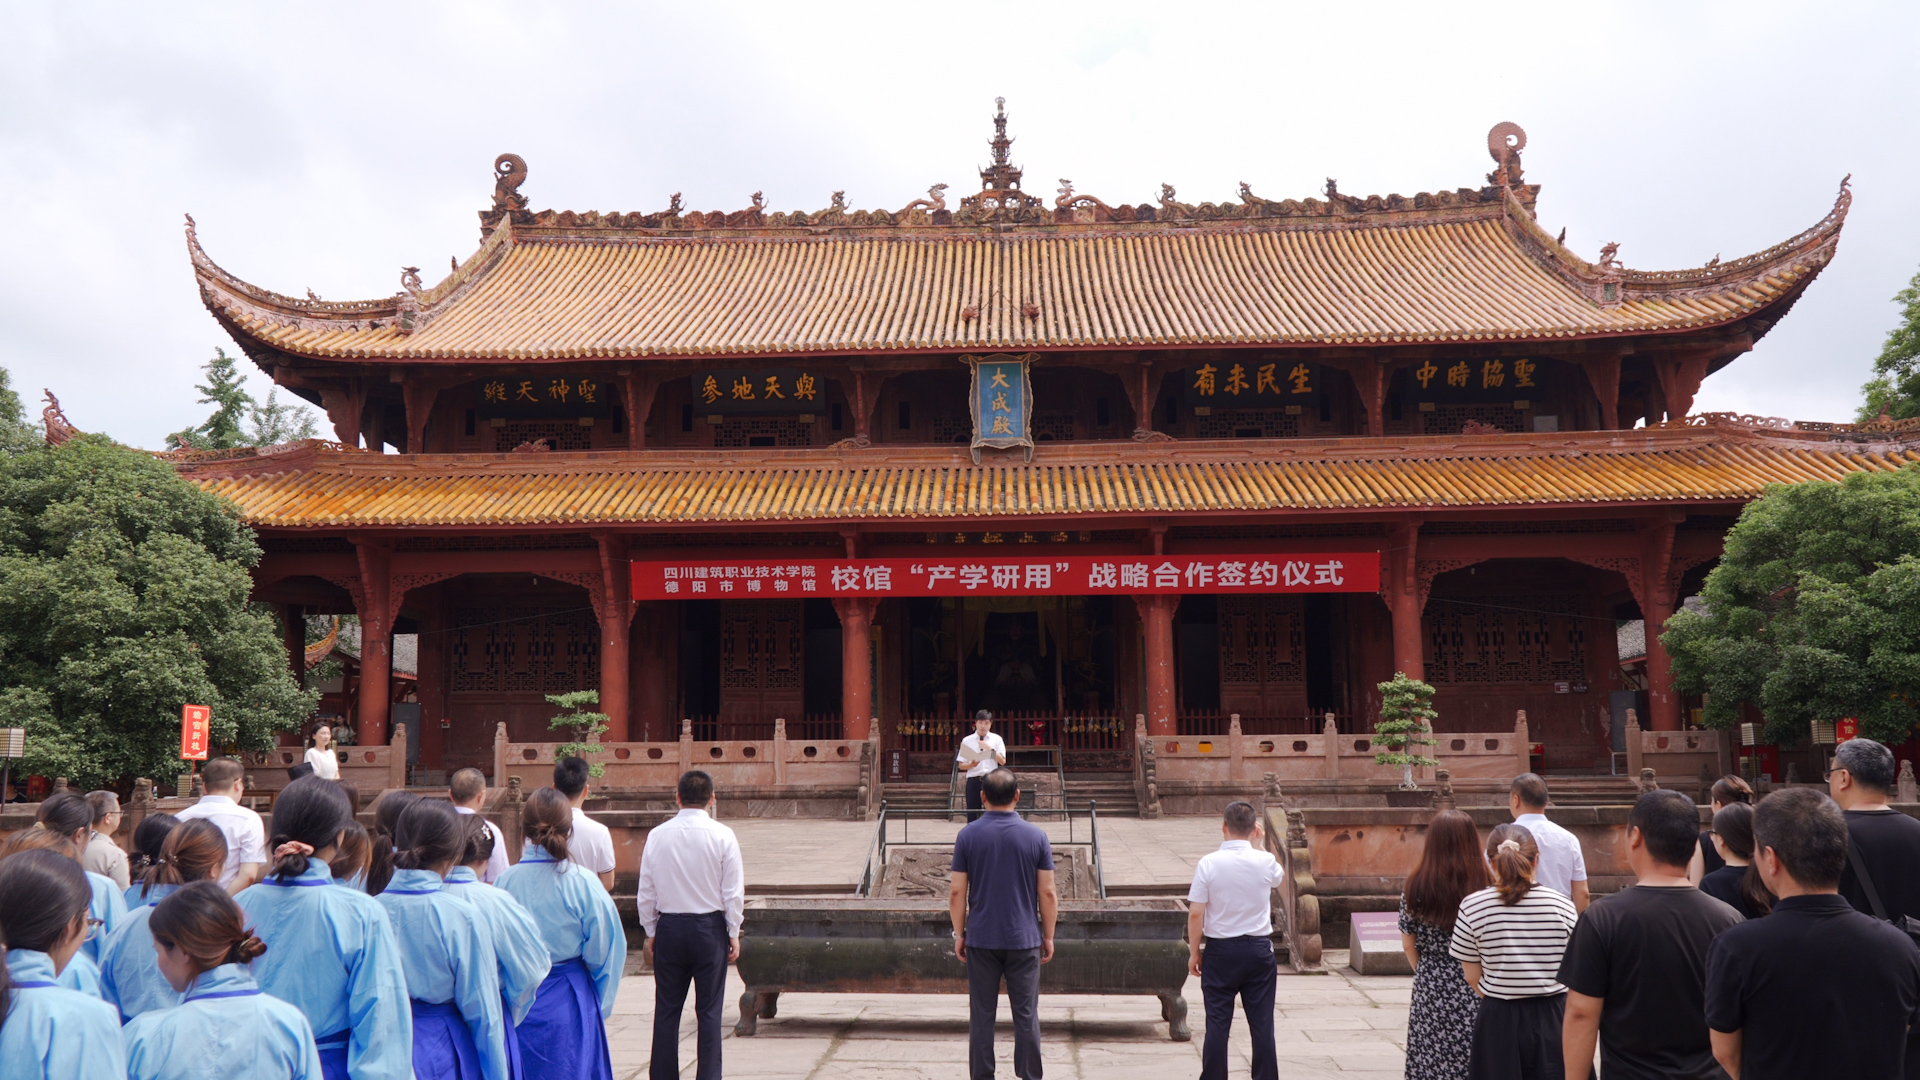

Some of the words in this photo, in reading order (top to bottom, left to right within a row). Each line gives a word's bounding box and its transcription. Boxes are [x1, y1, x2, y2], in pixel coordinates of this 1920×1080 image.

[990, 367, 1013, 435] 大成殿
[664, 565, 816, 579] 四川建筑职业技术学院
[664, 579, 816, 593] 德阳市博物馆
